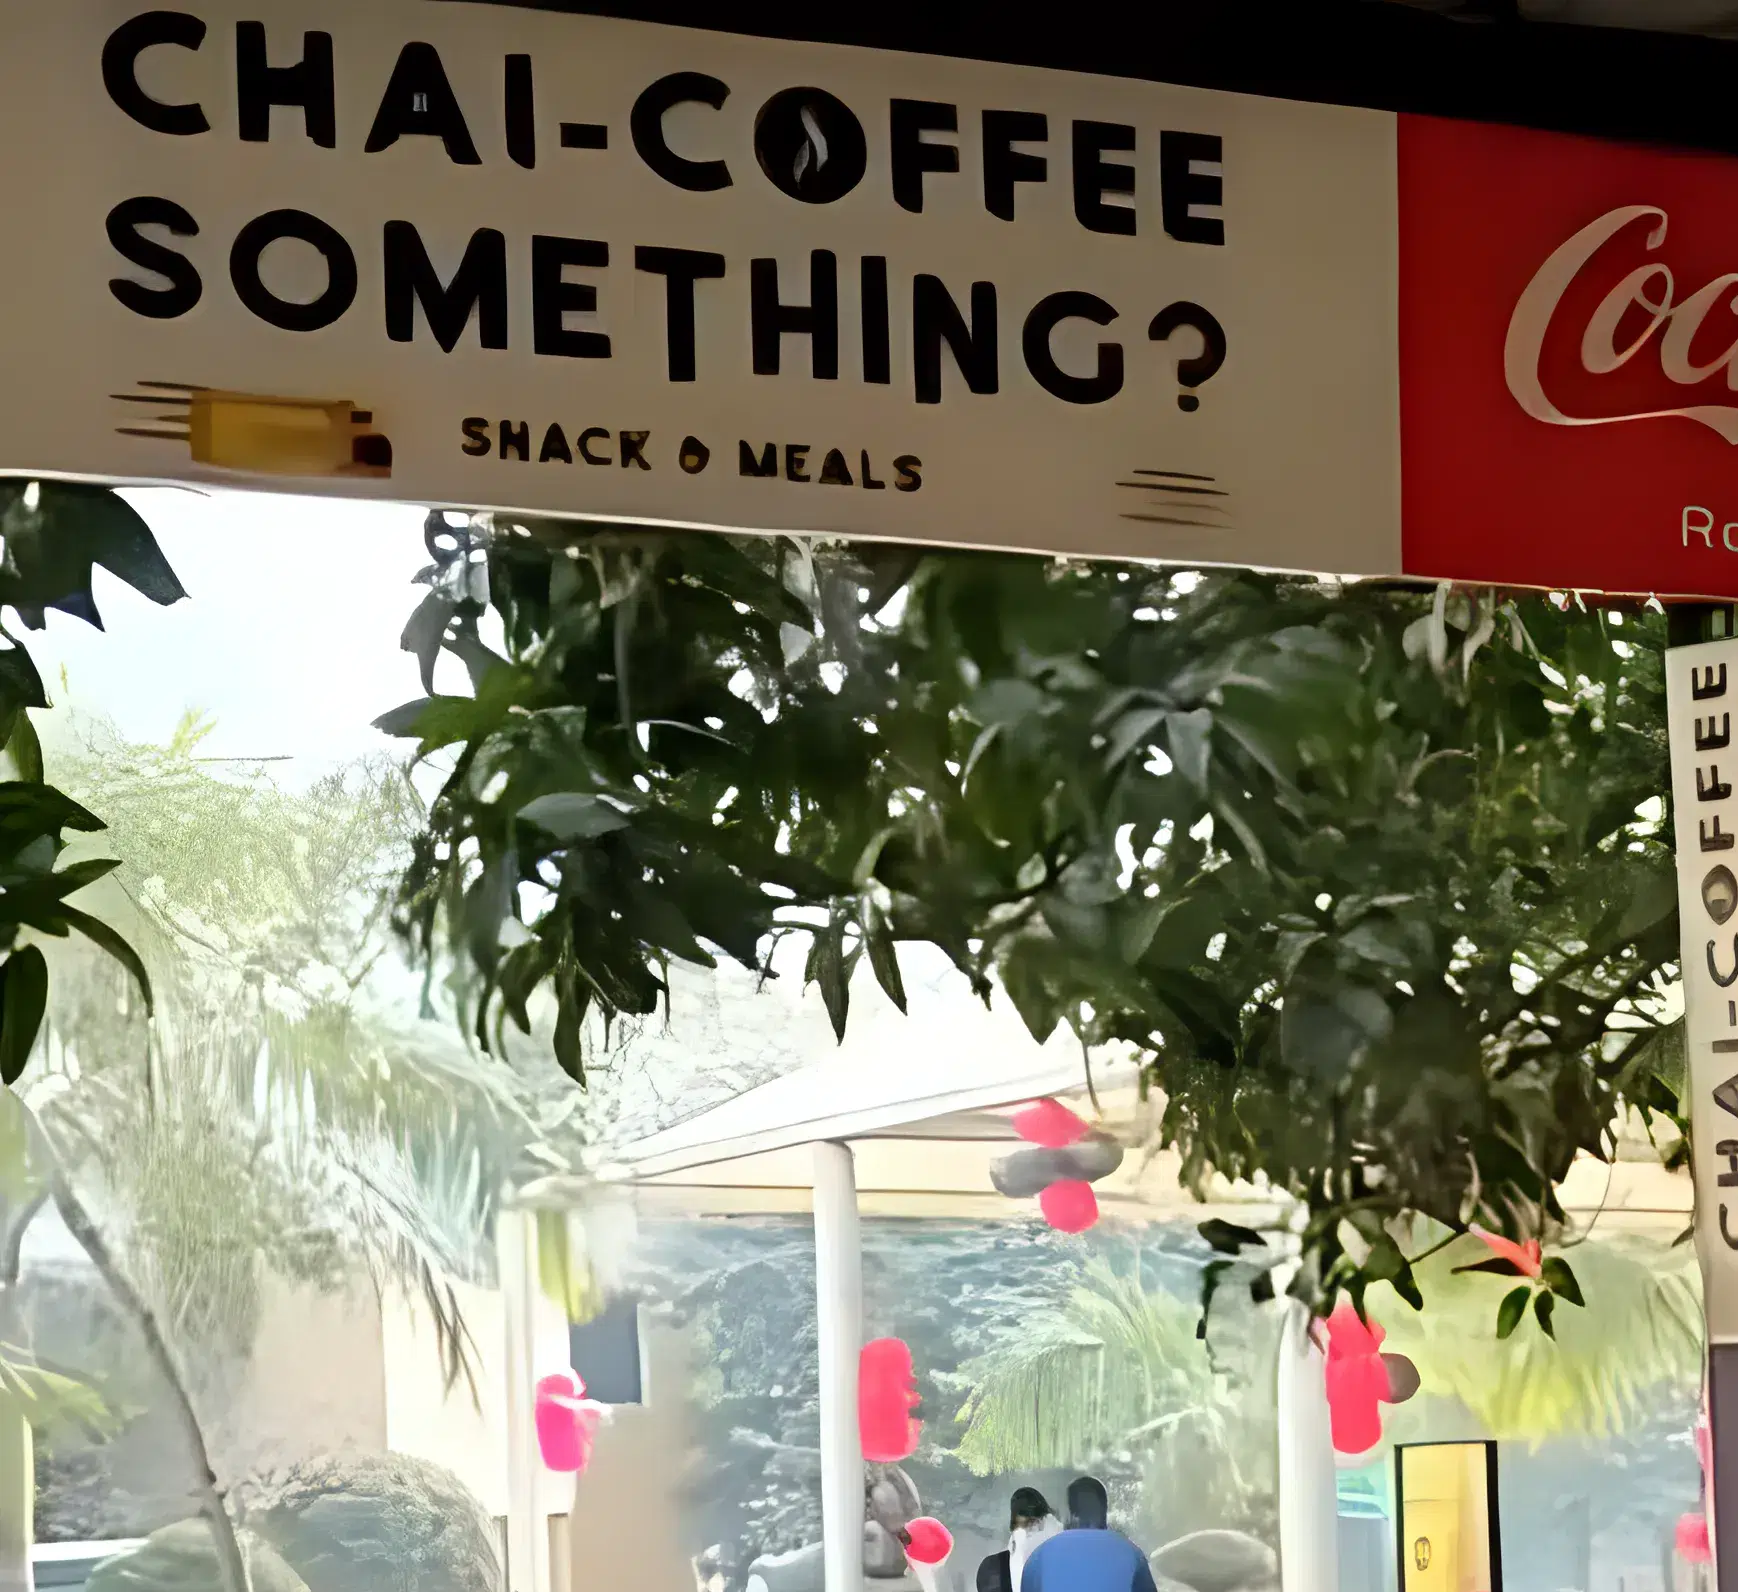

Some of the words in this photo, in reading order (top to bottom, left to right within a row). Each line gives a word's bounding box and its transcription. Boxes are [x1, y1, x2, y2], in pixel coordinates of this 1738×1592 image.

[101, 10, 1226, 246] CHAI-COFFEE
[105, 196, 1228, 413] SOMETHING?
[738, 439, 922, 493] MEALS
